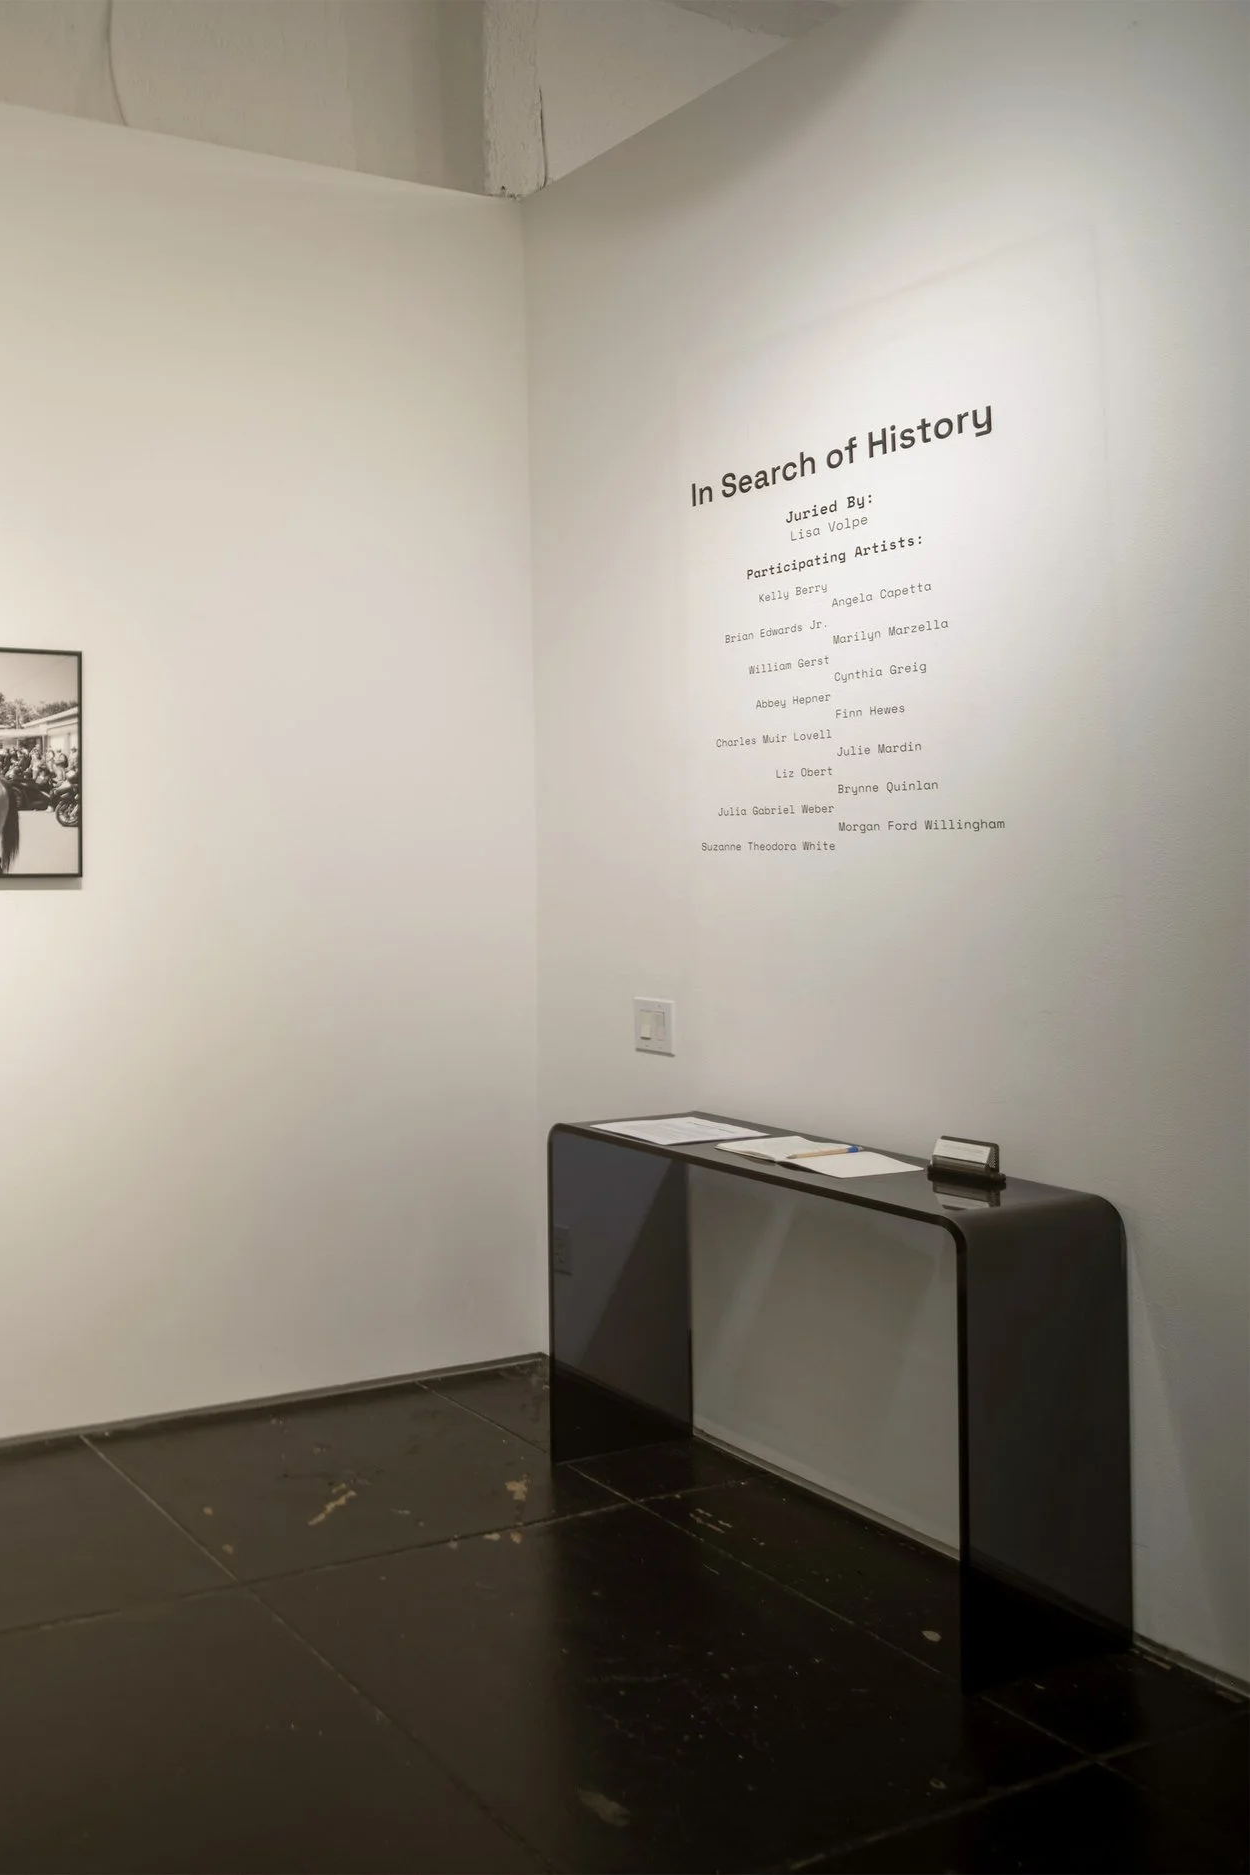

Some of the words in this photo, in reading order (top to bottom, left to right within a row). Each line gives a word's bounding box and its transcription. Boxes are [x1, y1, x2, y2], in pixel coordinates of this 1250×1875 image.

[691, 482, 713, 507] In
[721, 451, 816, 498] Search
[826, 437, 858, 470] of
[868, 406, 993, 458] History
[786, 500, 838, 524] Juried
[847, 493, 873, 509] By:
[790, 526, 821, 541] Lisa
[828, 514, 868, 533] Volpe
[746, 550, 846, 580] Participating
[854, 535, 923, 558] Artists:
[758, 589, 789, 603] Kelly
[796, 582, 828, 596] Berry
[831, 592, 872, 608] Angela
[880, 582, 932, 600] Capetta
[724, 631, 754, 644] Brian
[760, 622, 803, 638] Edwards
[810, 619, 827, 630] Jr.
[832, 628, 881, 645] Marilyn
[888, 618, 949, 637] Marzella
[748, 662, 792, 675] William
[798, 656, 830, 669] Gerst
[834, 667, 883, 683] Cynthia
[890, 661, 927, 676] Greig
[756, 697, 786, 709] Abbey
[792, 693, 831, 706] Hepner
[835, 708, 862, 719] Finn
[870, 704, 905, 715] Hewes
[716, 736, 757, 748] Charles
[763, 733, 787, 744] Muir
[793, 729, 832, 742] Lovell
[837, 745, 871, 757] Julie
[878, 741, 922, 754] Mardin
[776, 769, 794, 779] Liz
[801, 766, 833, 777] Obert
[838, 783, 879, 795] Brynne
[886, 780, 938, 793] Quinlan
[718, 807, 747, 817] Julia
[752, 805, 795, 816] Gabriel
[801, 804, 834, 814] Weber
[838, 821, 880, 834] Morgan
[888, 820, 918, 831] Ford
[924, 818, 1006, 832] Willingham
[701, 842, 741, 851] Suzanne
[748, 842, 797, 851] Theodora
[802, 841, 835, 851] White
